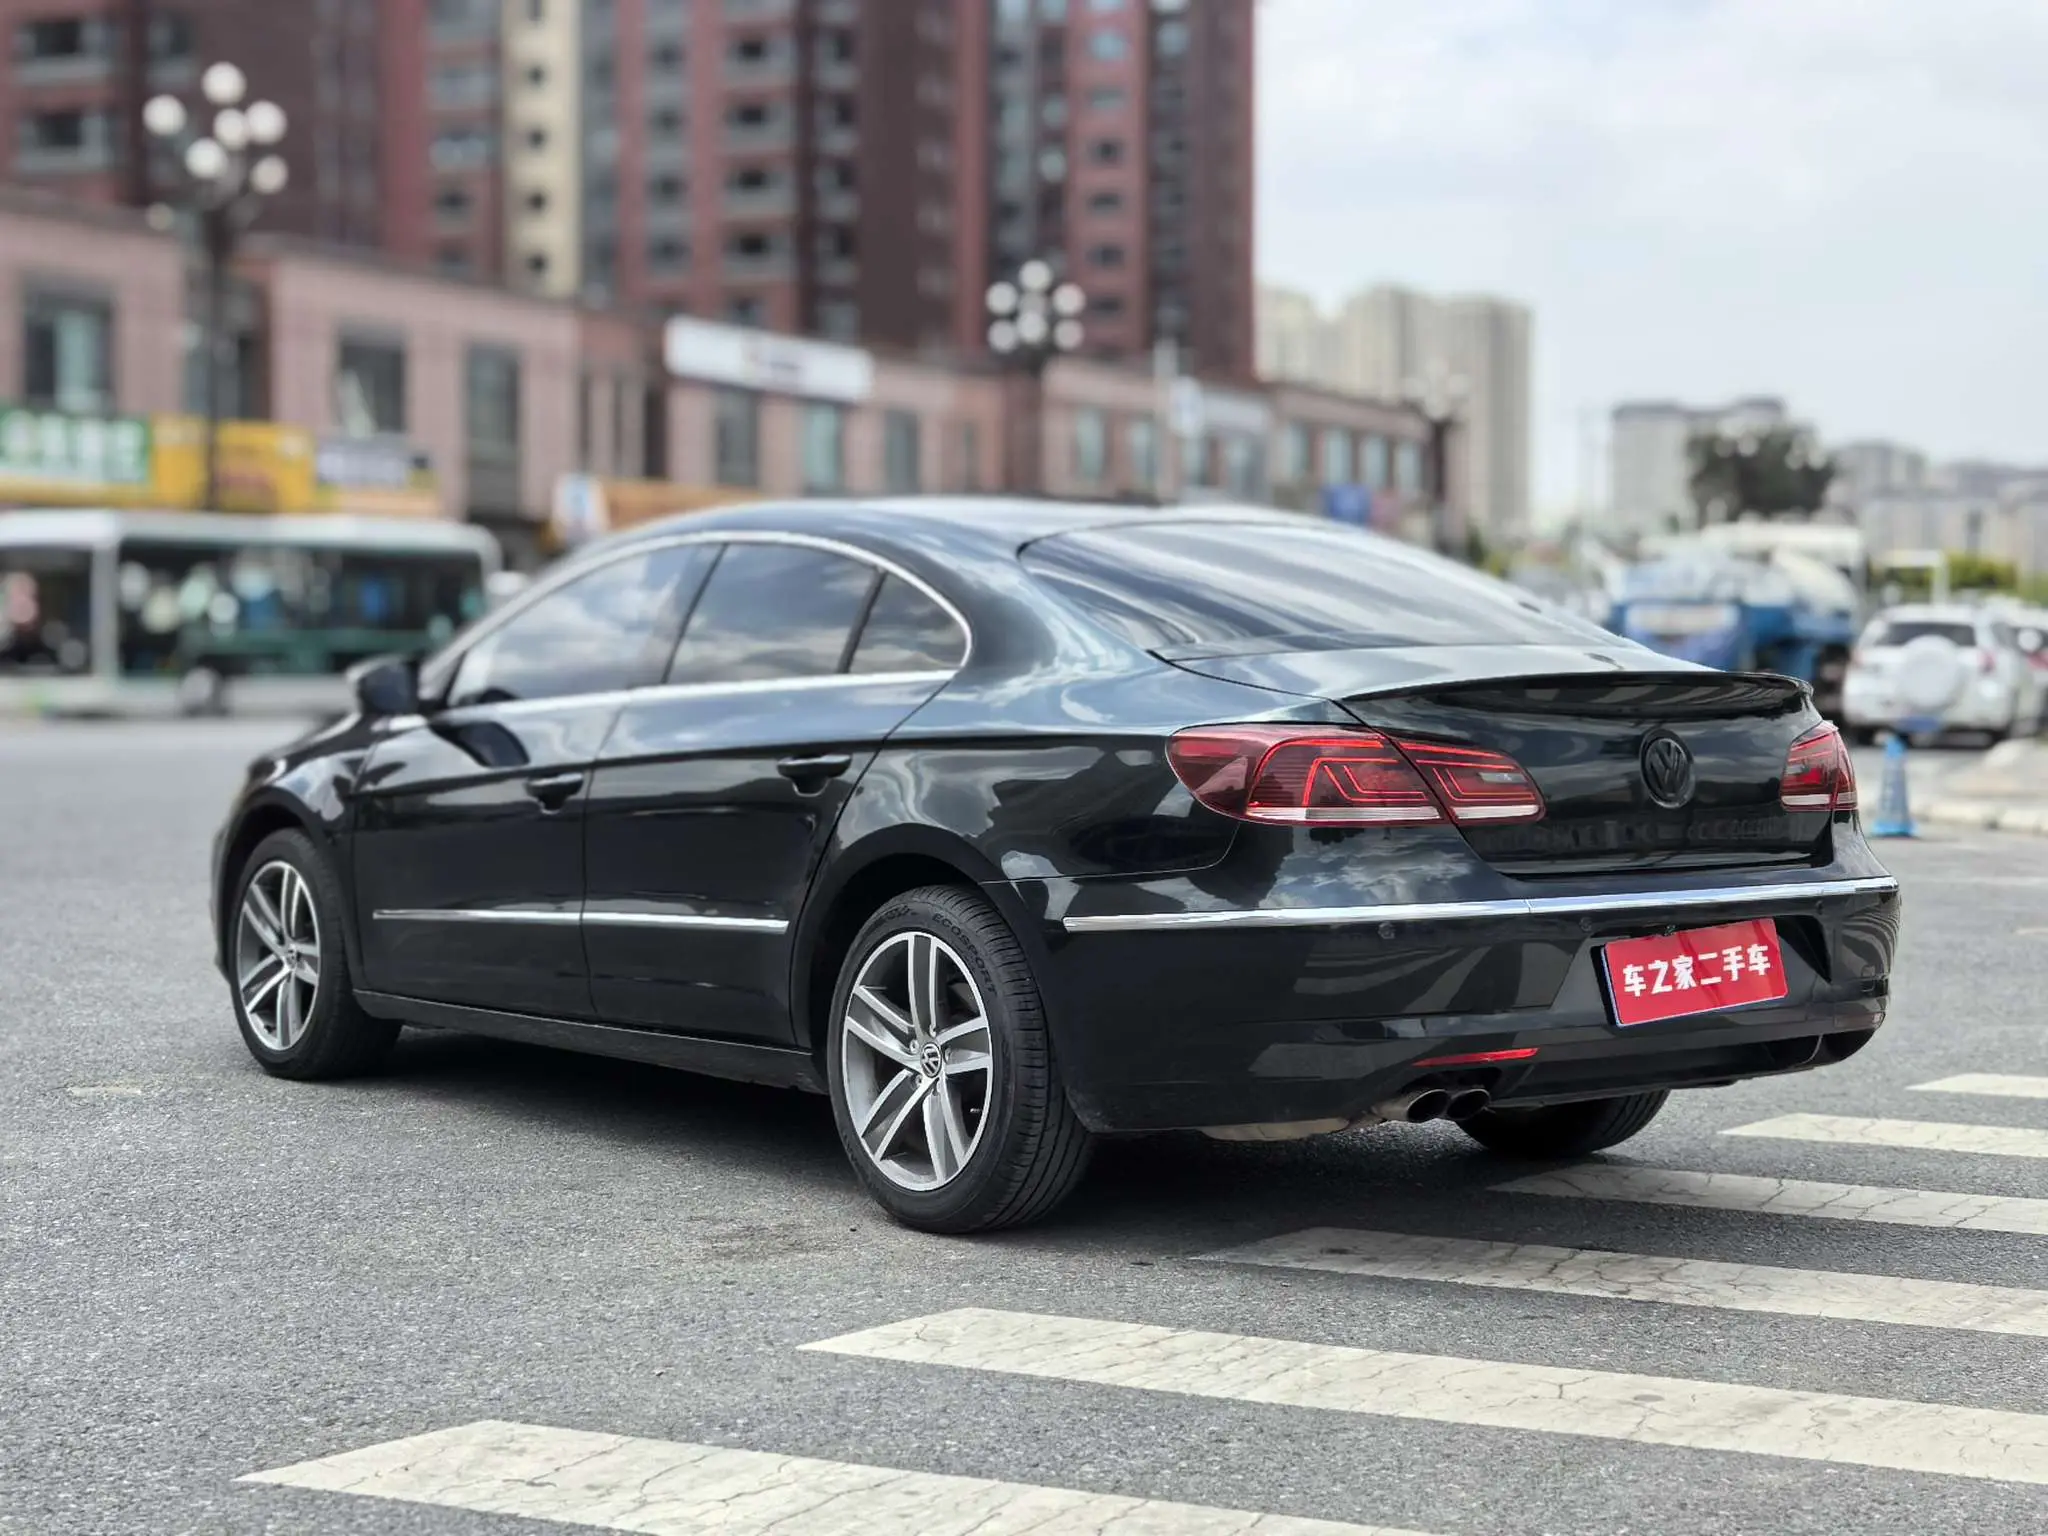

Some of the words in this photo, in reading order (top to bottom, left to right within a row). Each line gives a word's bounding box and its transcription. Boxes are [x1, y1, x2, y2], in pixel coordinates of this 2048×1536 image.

[1622, 943, 1771, 997] 车之家二手车
